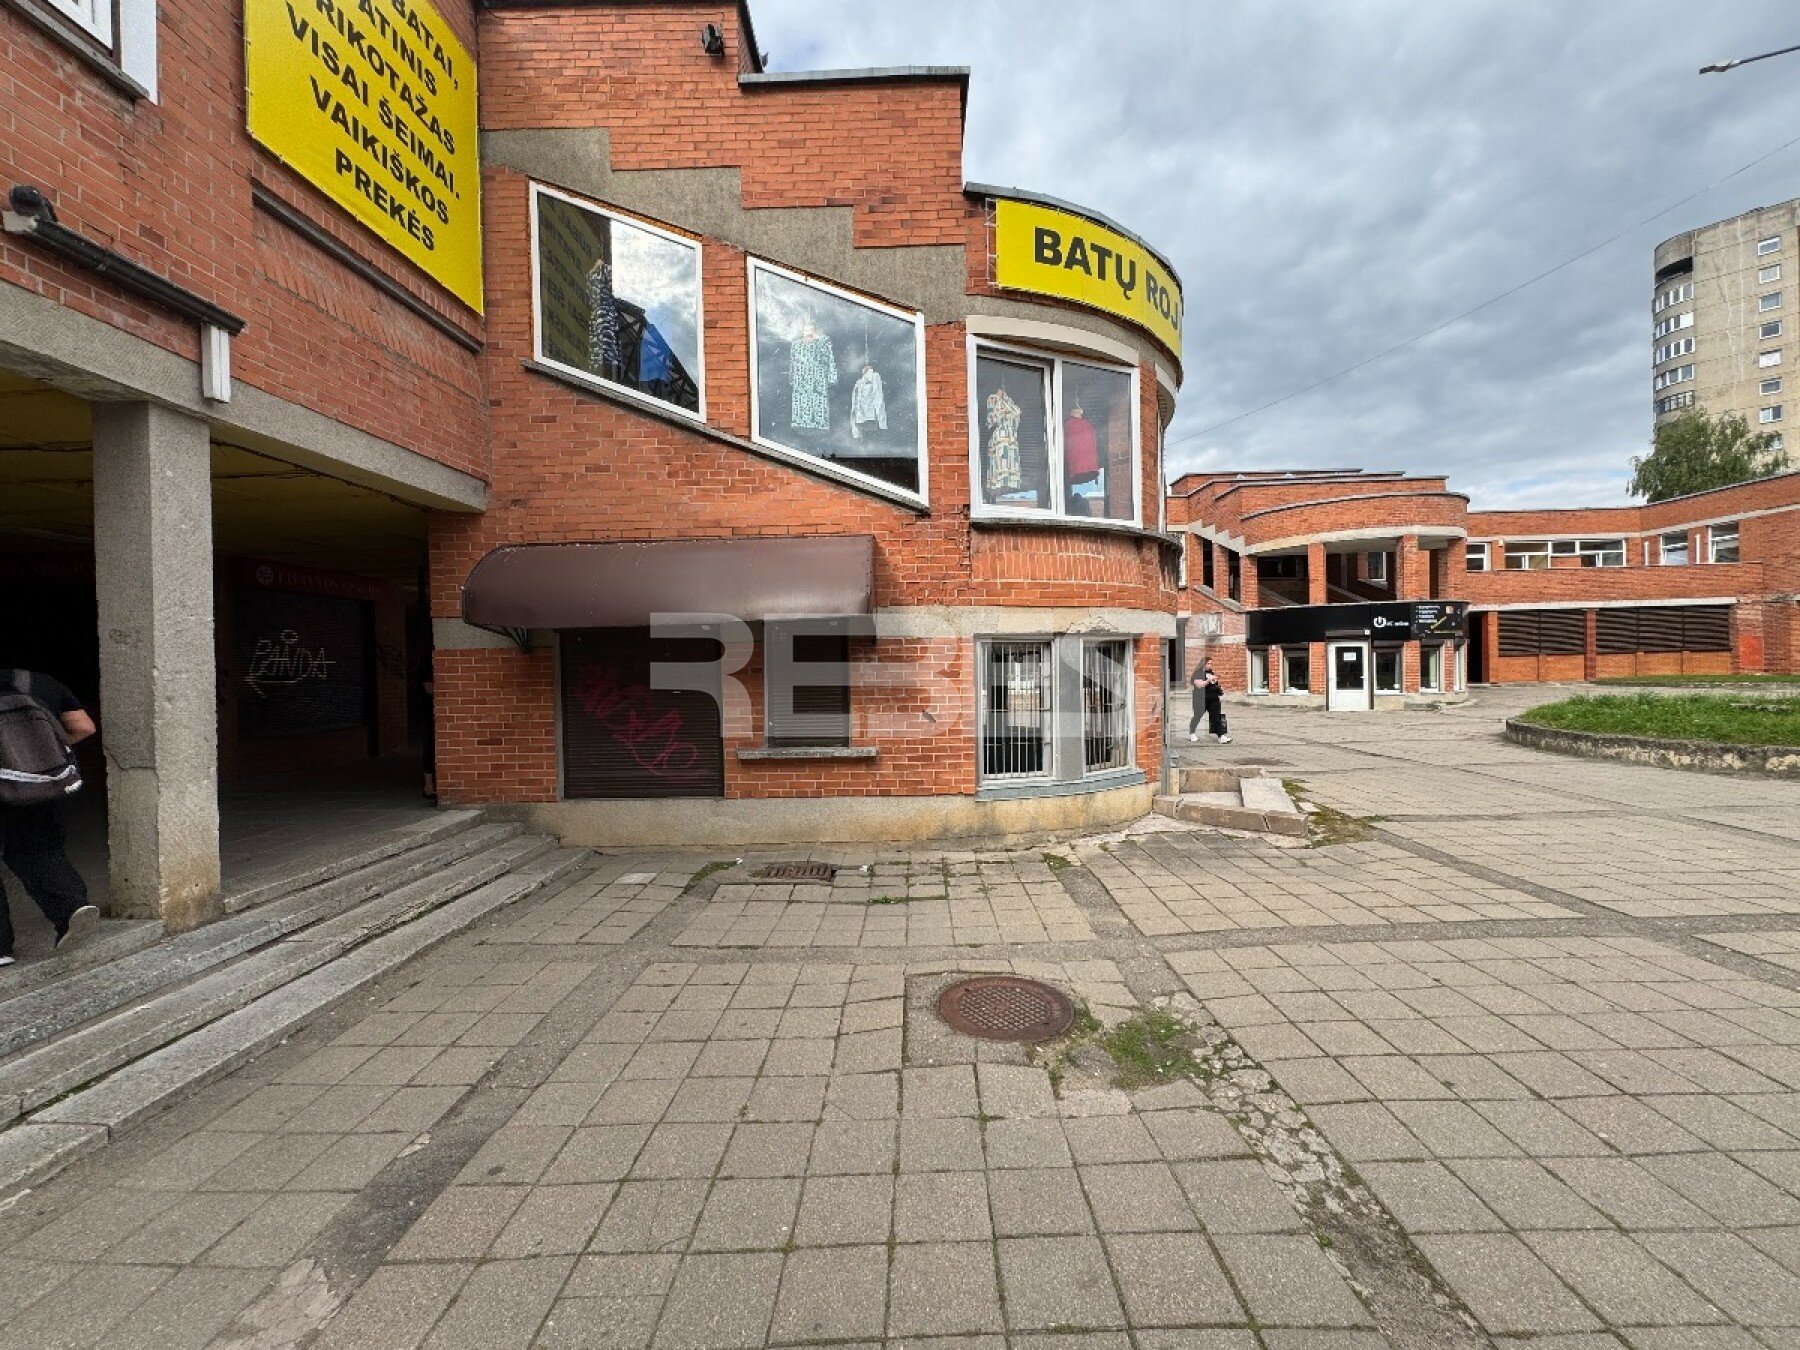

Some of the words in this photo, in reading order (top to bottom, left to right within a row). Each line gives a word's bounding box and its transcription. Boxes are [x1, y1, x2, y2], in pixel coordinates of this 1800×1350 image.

[285, 0, 370, 107] VISAI
[378, 95, 460, 200] ŠEIMAI.
[309, 74, 450, 225] VAIKIŠKOS
[335, 147, 435, 251] PREKĖS
[1034, 225, 1136, 301] BATŲ
